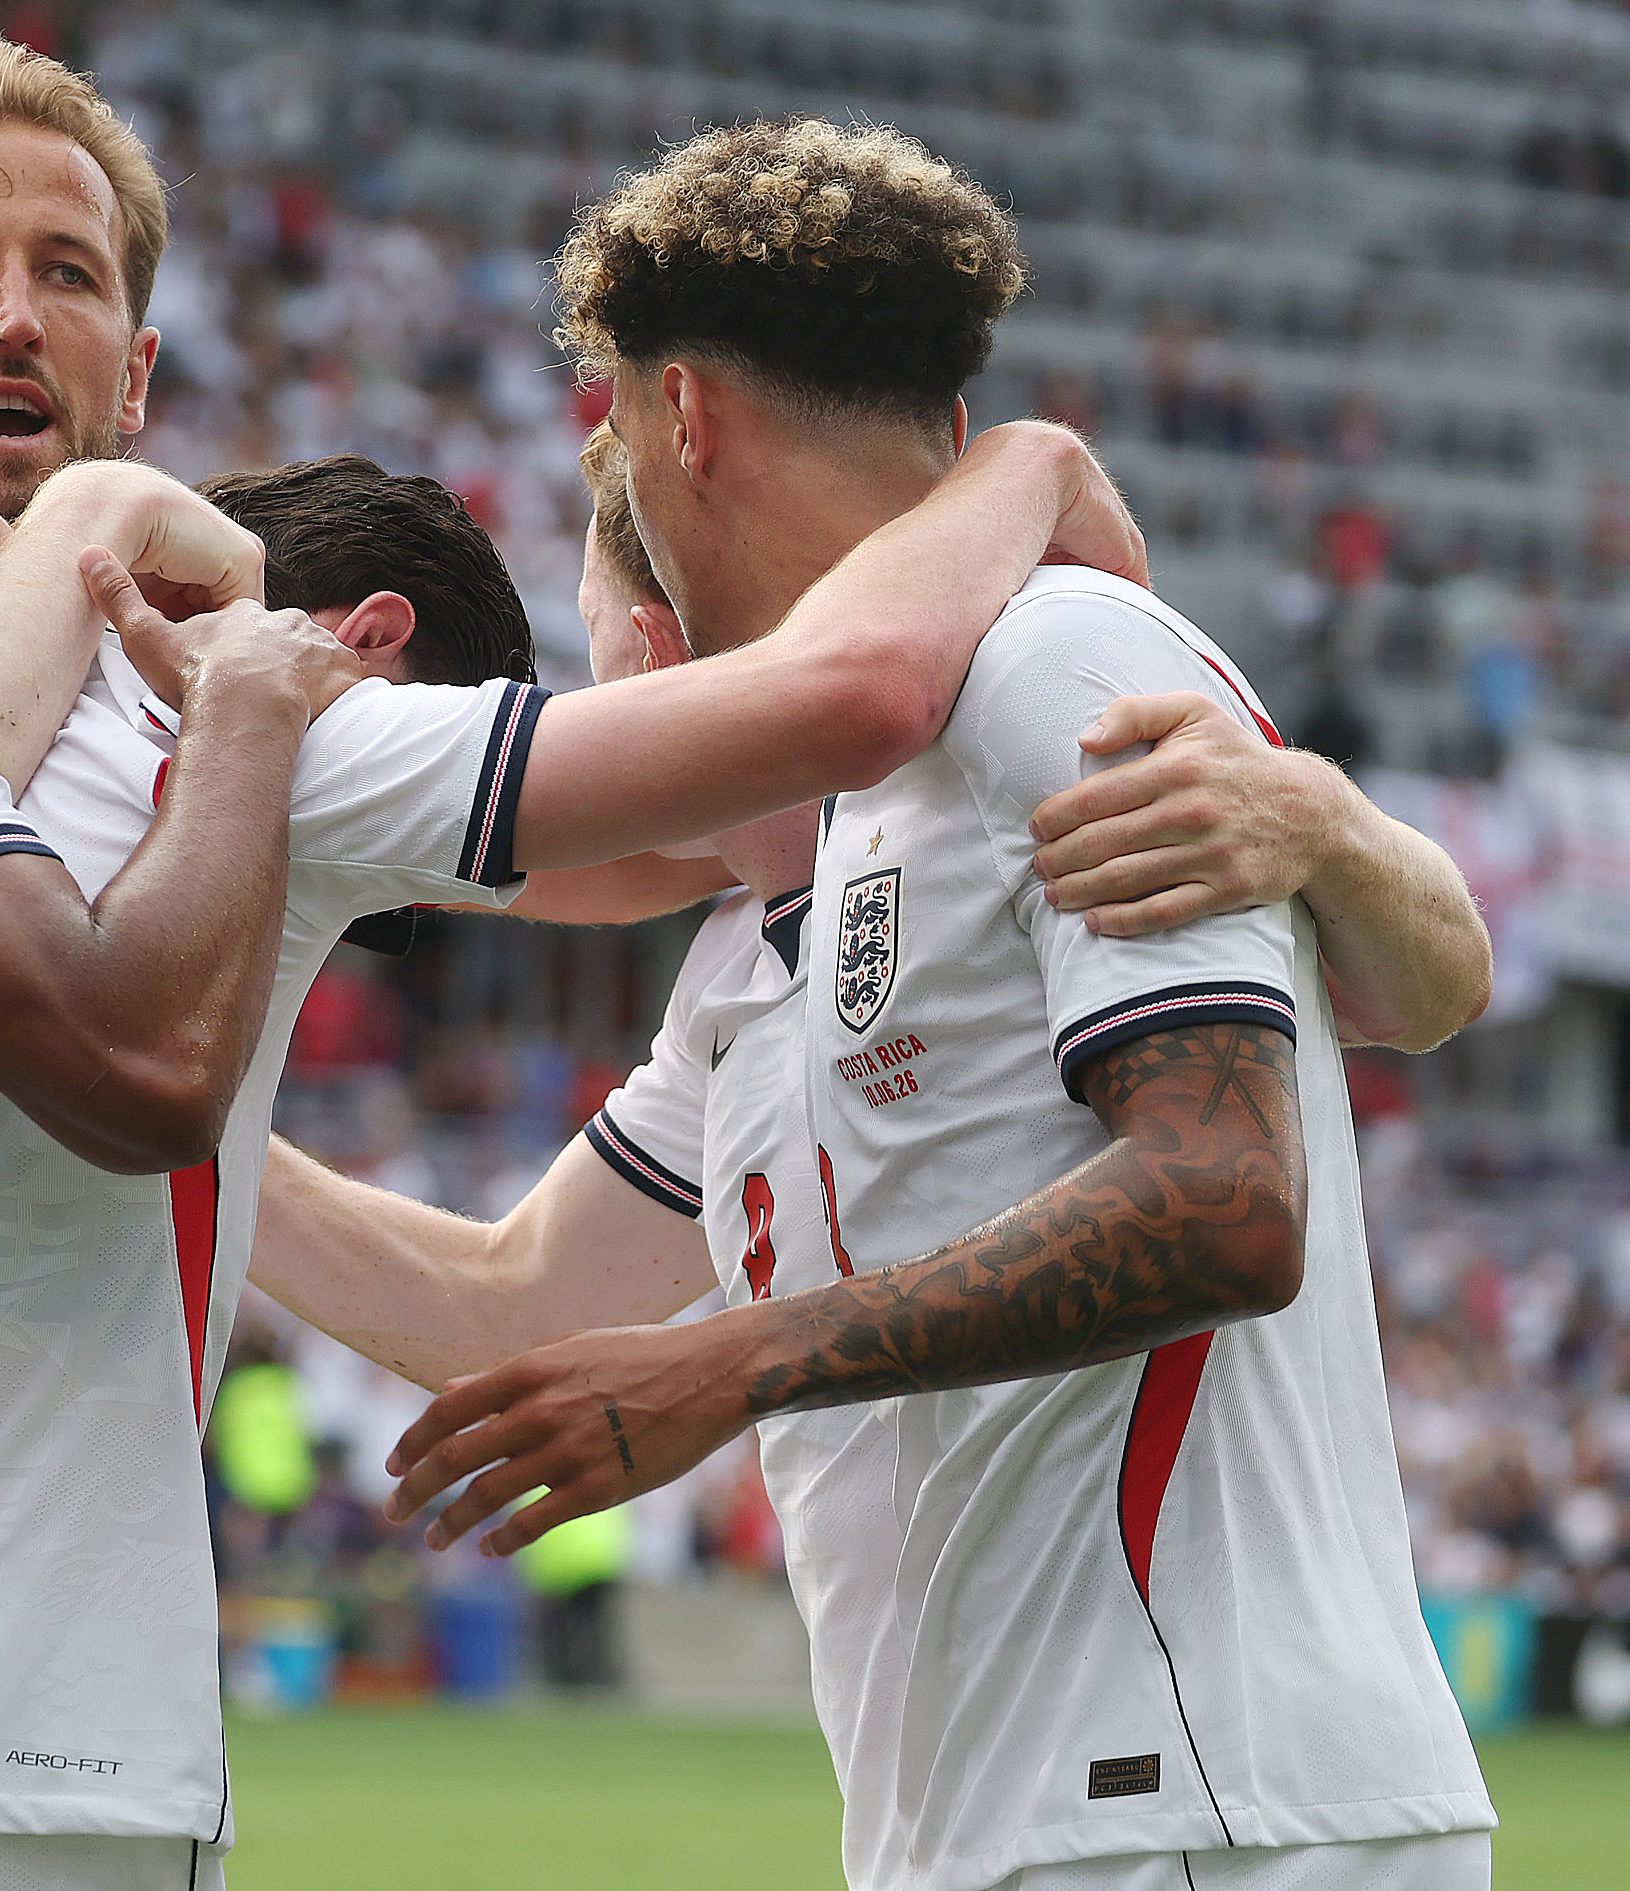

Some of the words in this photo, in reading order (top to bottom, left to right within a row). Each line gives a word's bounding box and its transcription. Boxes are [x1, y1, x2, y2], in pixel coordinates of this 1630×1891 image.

[837, 1052, 879, 1081] COSTA
[874, 1034, 928, 1069] RICA
[861, 1069, 919, 1109] 10.06.26
[6, 1750, 123, 1775] AERO-FIT
